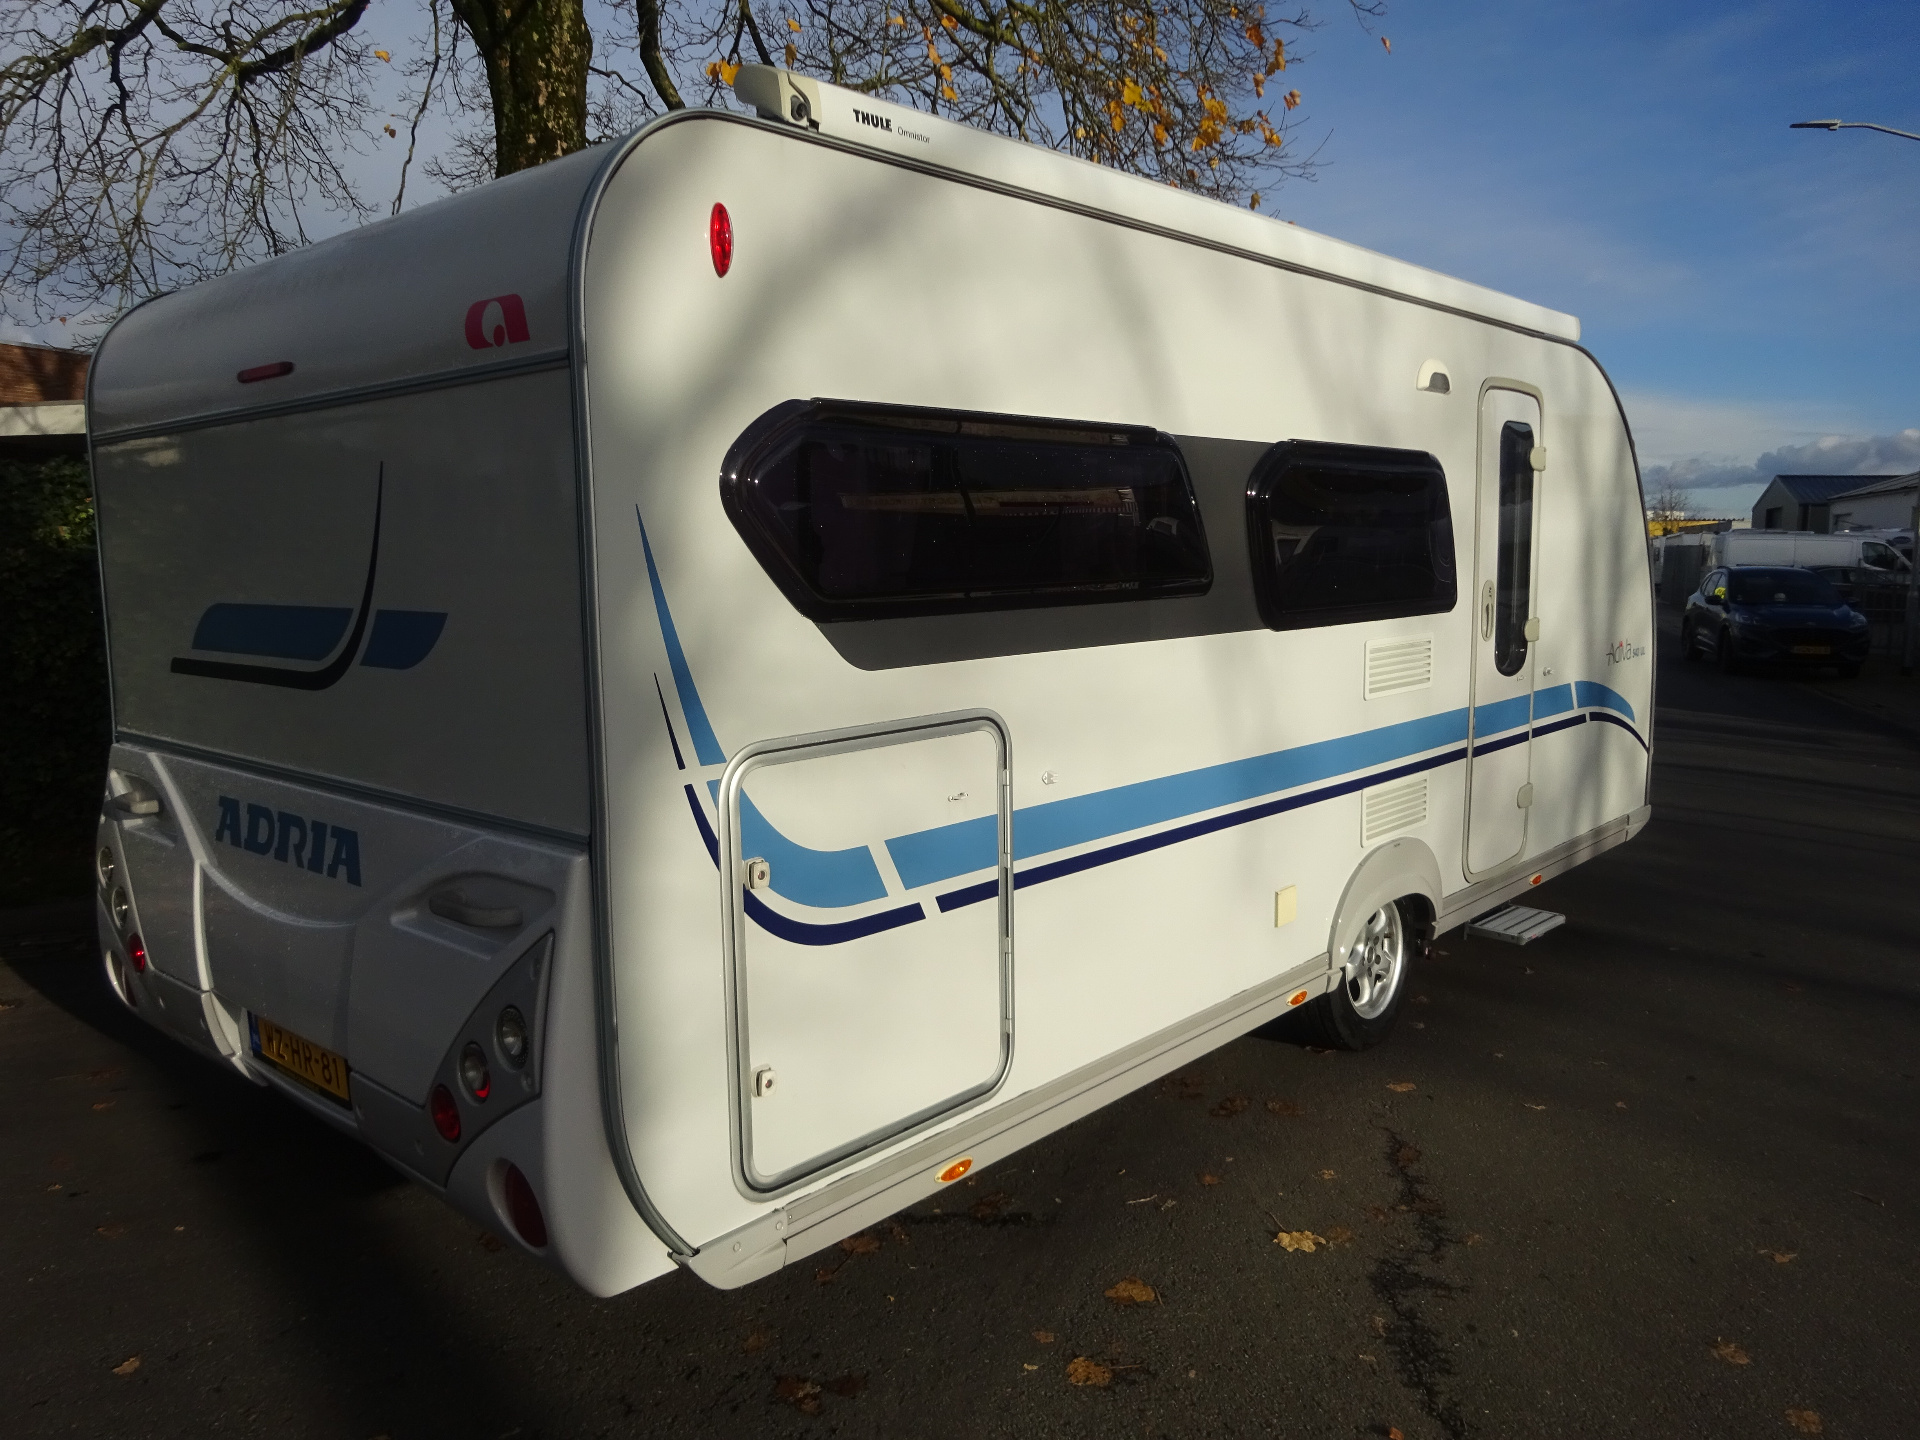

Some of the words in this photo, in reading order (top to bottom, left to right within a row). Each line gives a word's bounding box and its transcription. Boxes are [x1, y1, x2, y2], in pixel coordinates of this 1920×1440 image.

[853, 108, 892, 132] THULE
[898, 126, 931, 144] Omnistor
[215, 795, 362, 888] ADRIA
[264, 1021, 341, 1091] WZ-HR-81
